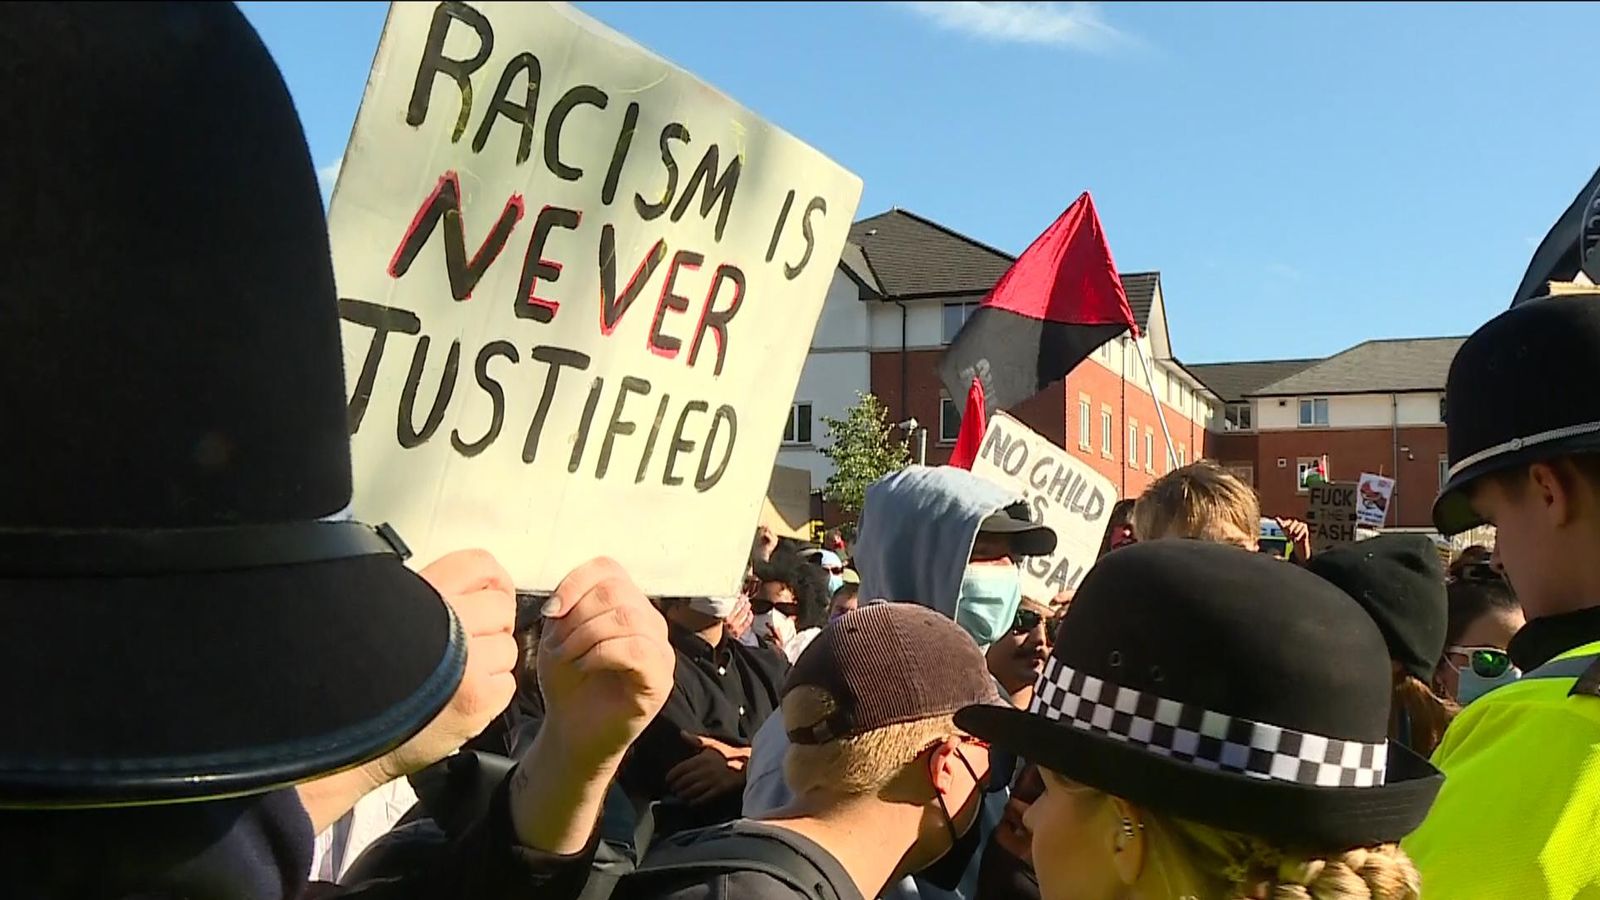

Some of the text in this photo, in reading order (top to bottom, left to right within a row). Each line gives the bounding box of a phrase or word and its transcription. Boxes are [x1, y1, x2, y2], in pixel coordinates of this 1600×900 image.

[405, 1, 827, 280] RACISM IS
[387, 169, 747, 377] NEVER
[338, 297, 737, 493] JUSTIFIED
[980, 423, 1105, 521] NO CHILD
[1310, 487, 1354, 506] FUCK
[1319, 508, 1345, 521] THE
[1308, 523, 1354, 541] FASH
